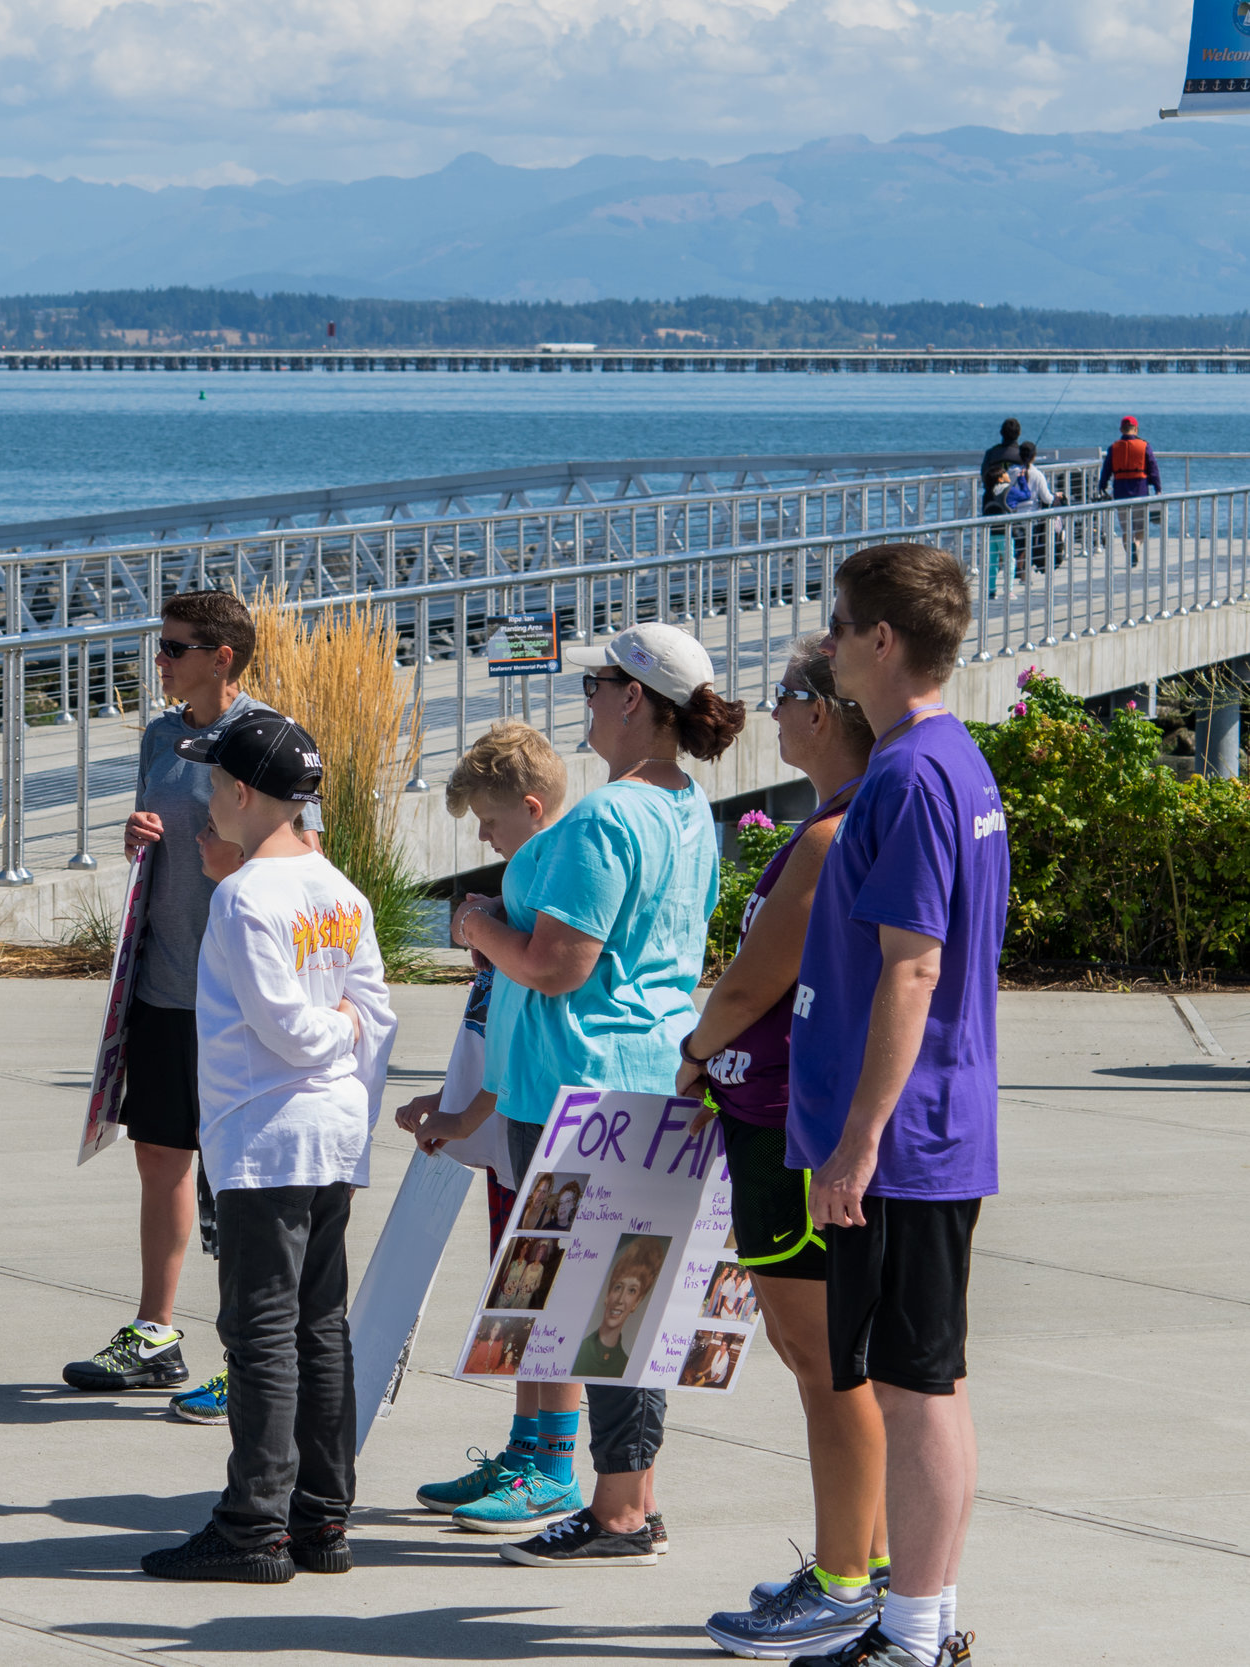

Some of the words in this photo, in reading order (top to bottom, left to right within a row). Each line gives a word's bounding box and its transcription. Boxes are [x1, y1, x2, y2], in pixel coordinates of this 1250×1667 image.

[500, 625, 527, 633] Planting
[528, 624, 543, 632] Area
[544, 1091, 631, 1163] FOR
[643, 1097, 732, 1184] FAM
